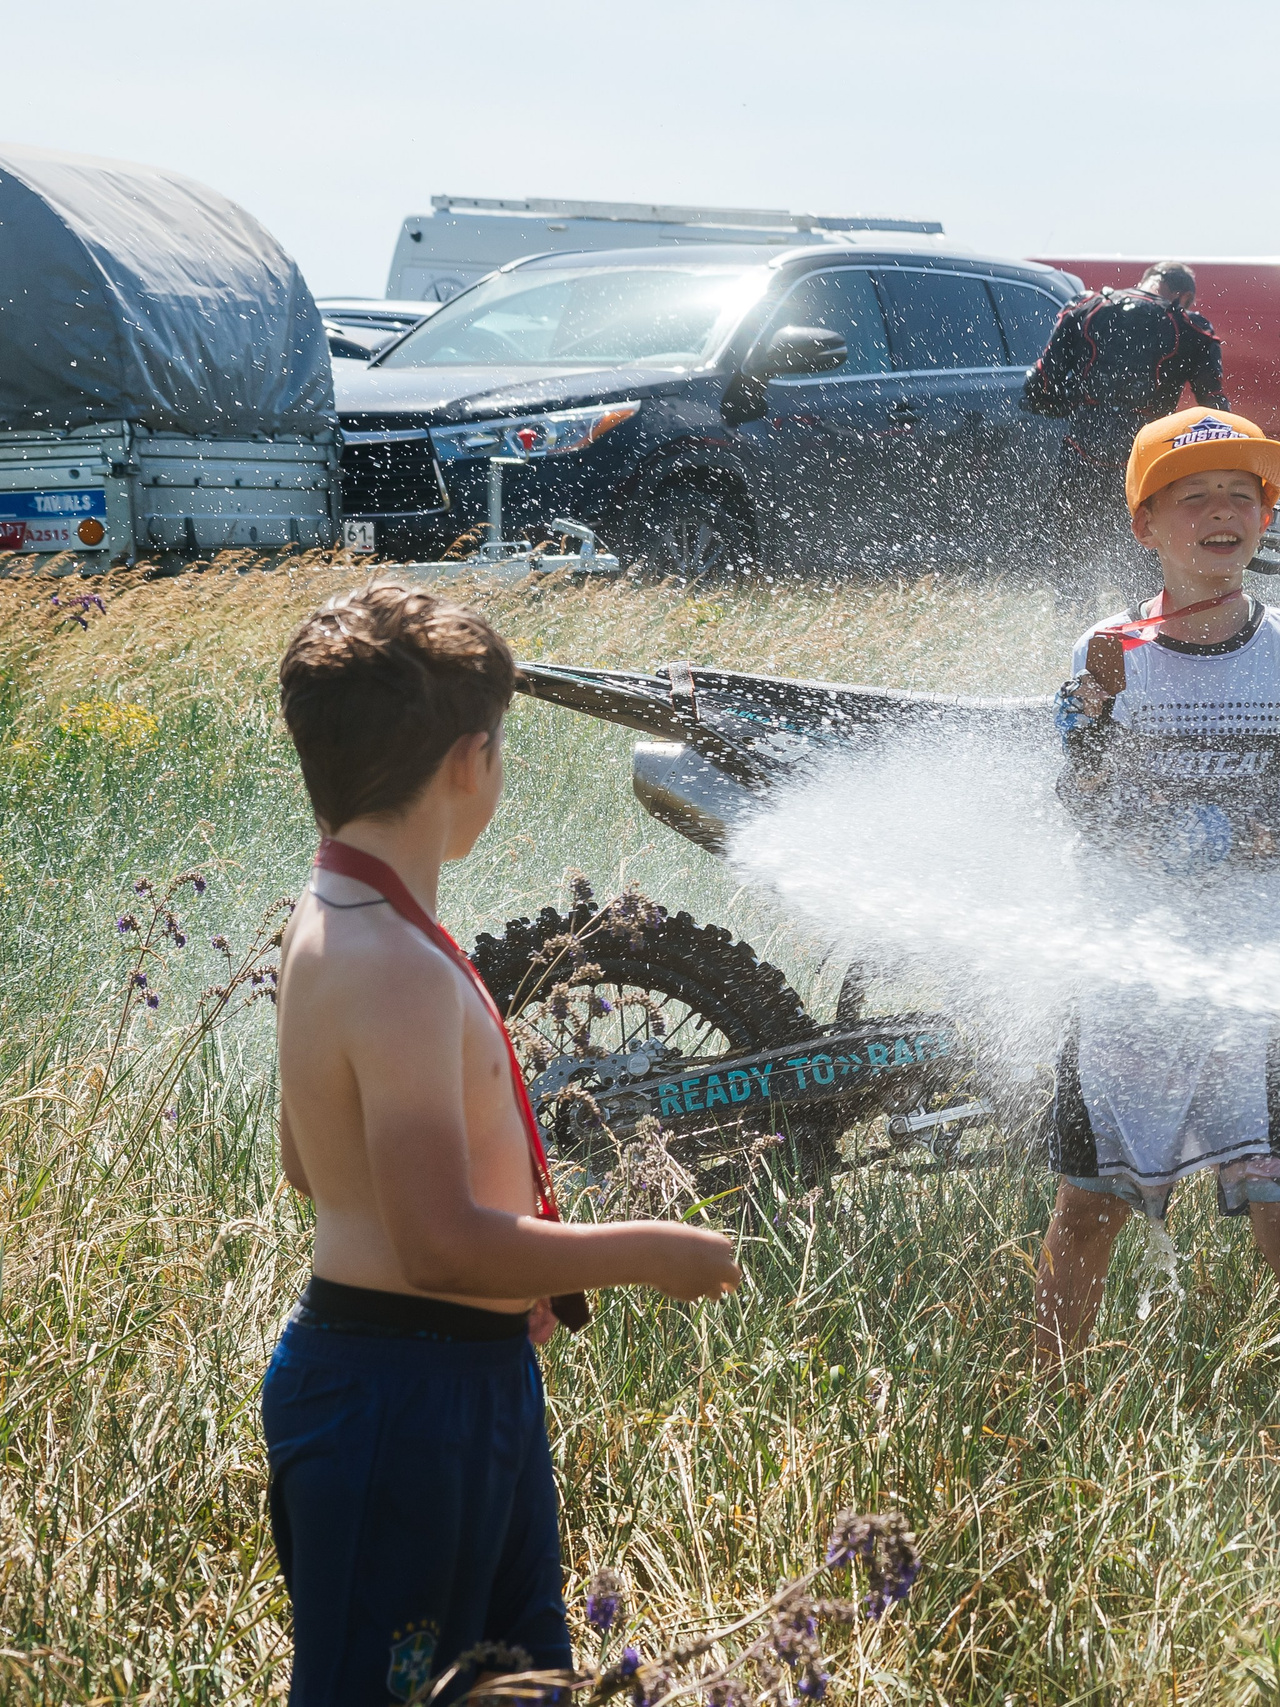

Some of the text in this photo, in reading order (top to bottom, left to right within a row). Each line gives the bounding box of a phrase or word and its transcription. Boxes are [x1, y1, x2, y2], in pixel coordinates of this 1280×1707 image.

[348, 524, 367, 543] 61
[658, 1063, 773, 1117] READY
[786, 1053, 836, 1090] TO
